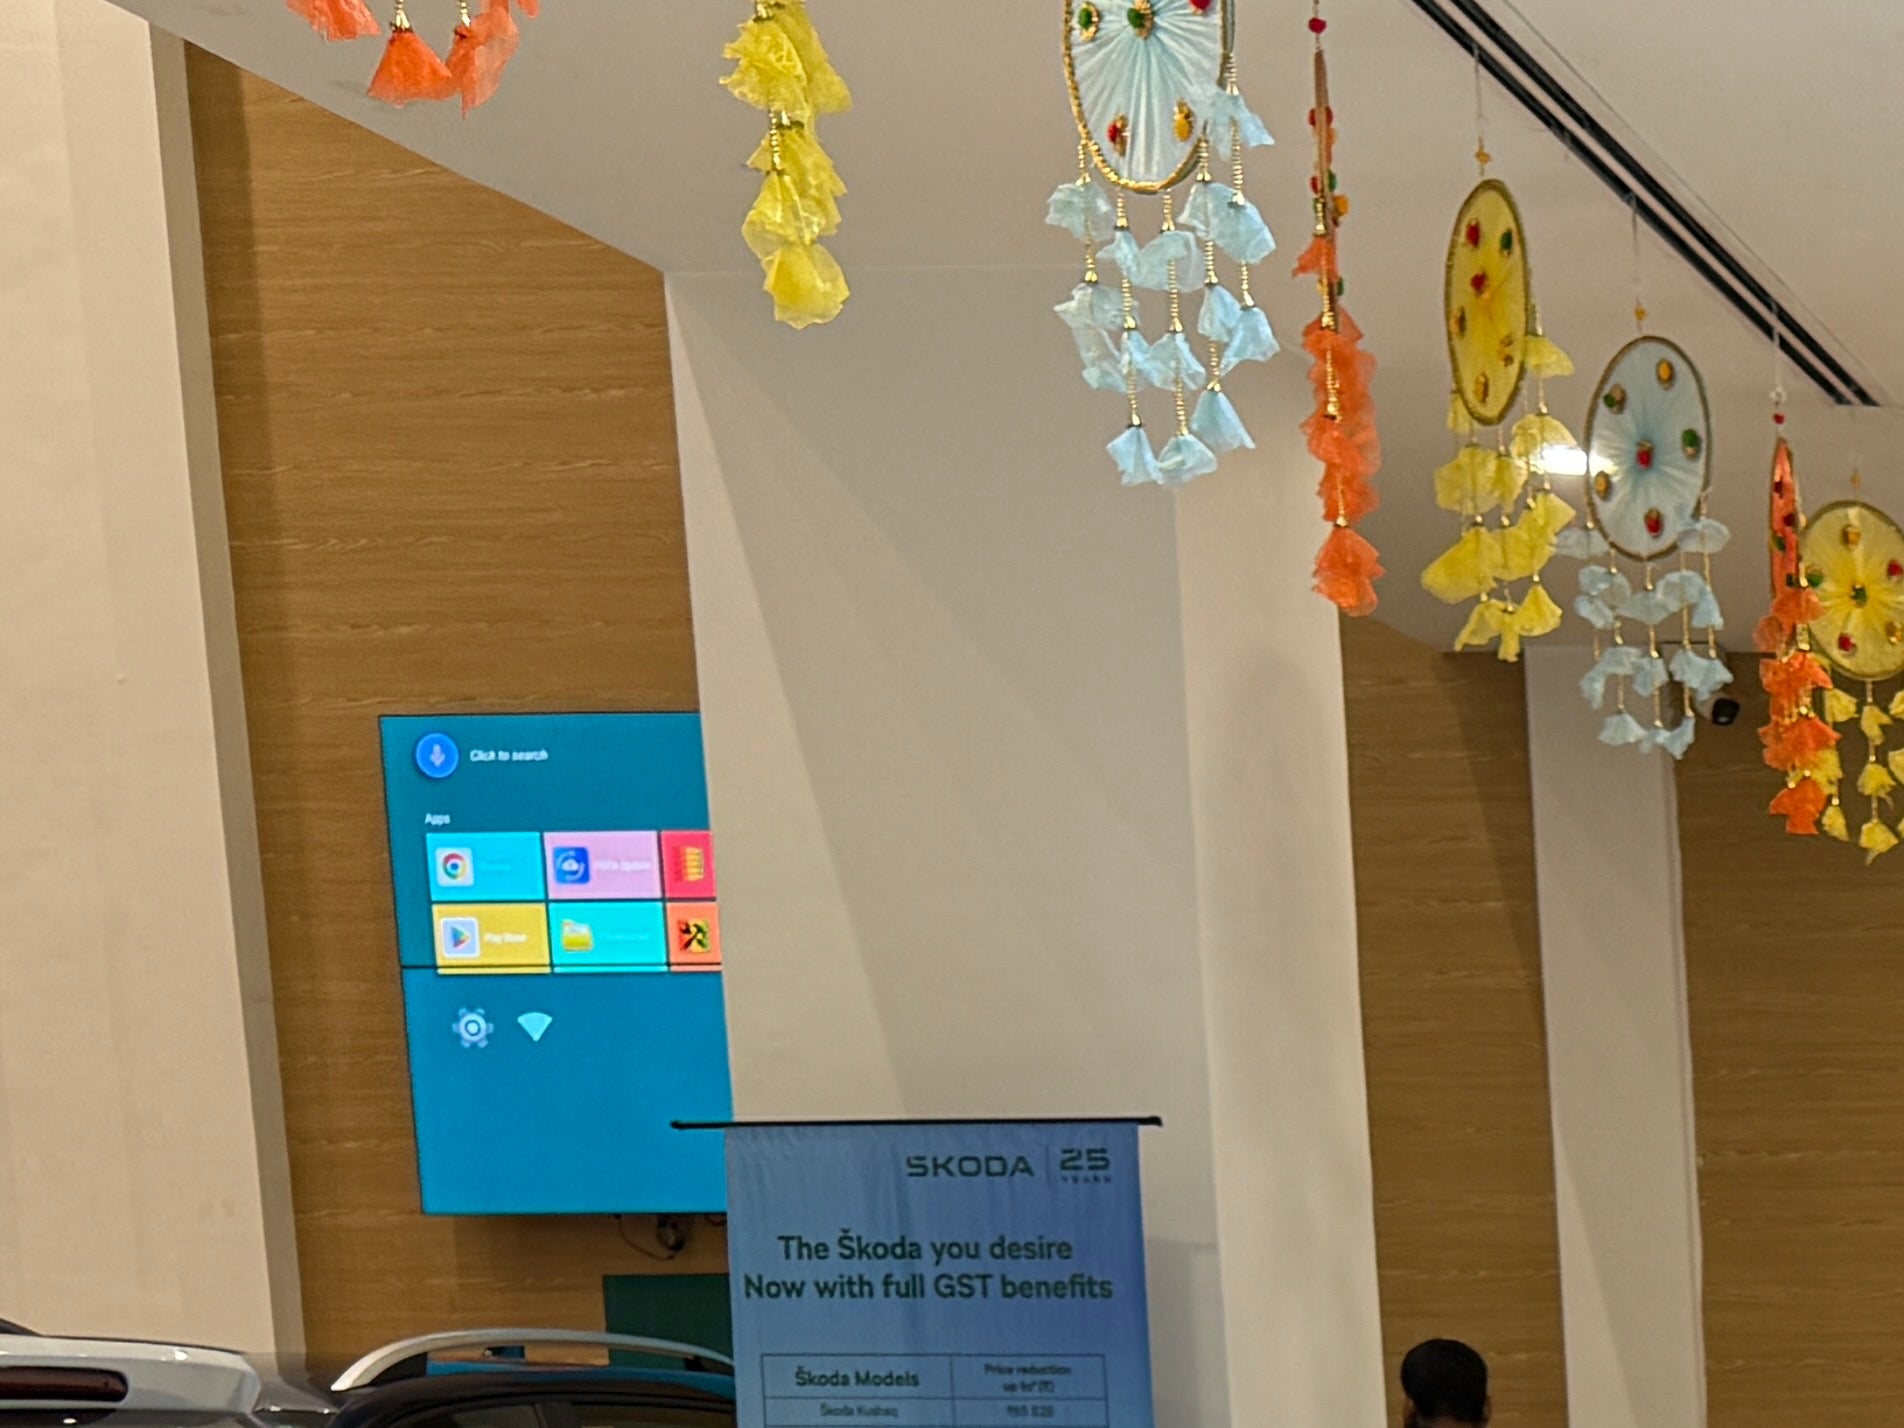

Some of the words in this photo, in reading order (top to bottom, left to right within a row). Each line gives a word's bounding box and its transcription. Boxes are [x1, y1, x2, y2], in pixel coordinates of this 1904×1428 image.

[424, 812, 451, 826] Apps
[1060, 1148, 1110, 1172] 25
[777, 1235, 830, 1260] The
[838, 1228, 922, 1260] Škoda
[930, 1241, 980, 1267] you
[990, 1235, 1073, 1260] desire
[743, 1274, 806, 1299] Now
[813, 1274, 874, 1298] with
[882, 1273, 925, 1299] full
[934, 1273, 993, 1299] GST
[1001, 1273, 1113, 1299] benefits
[795, 1366, 850, 1387] Škoda
[855, 1370, 920, 1387] Models
